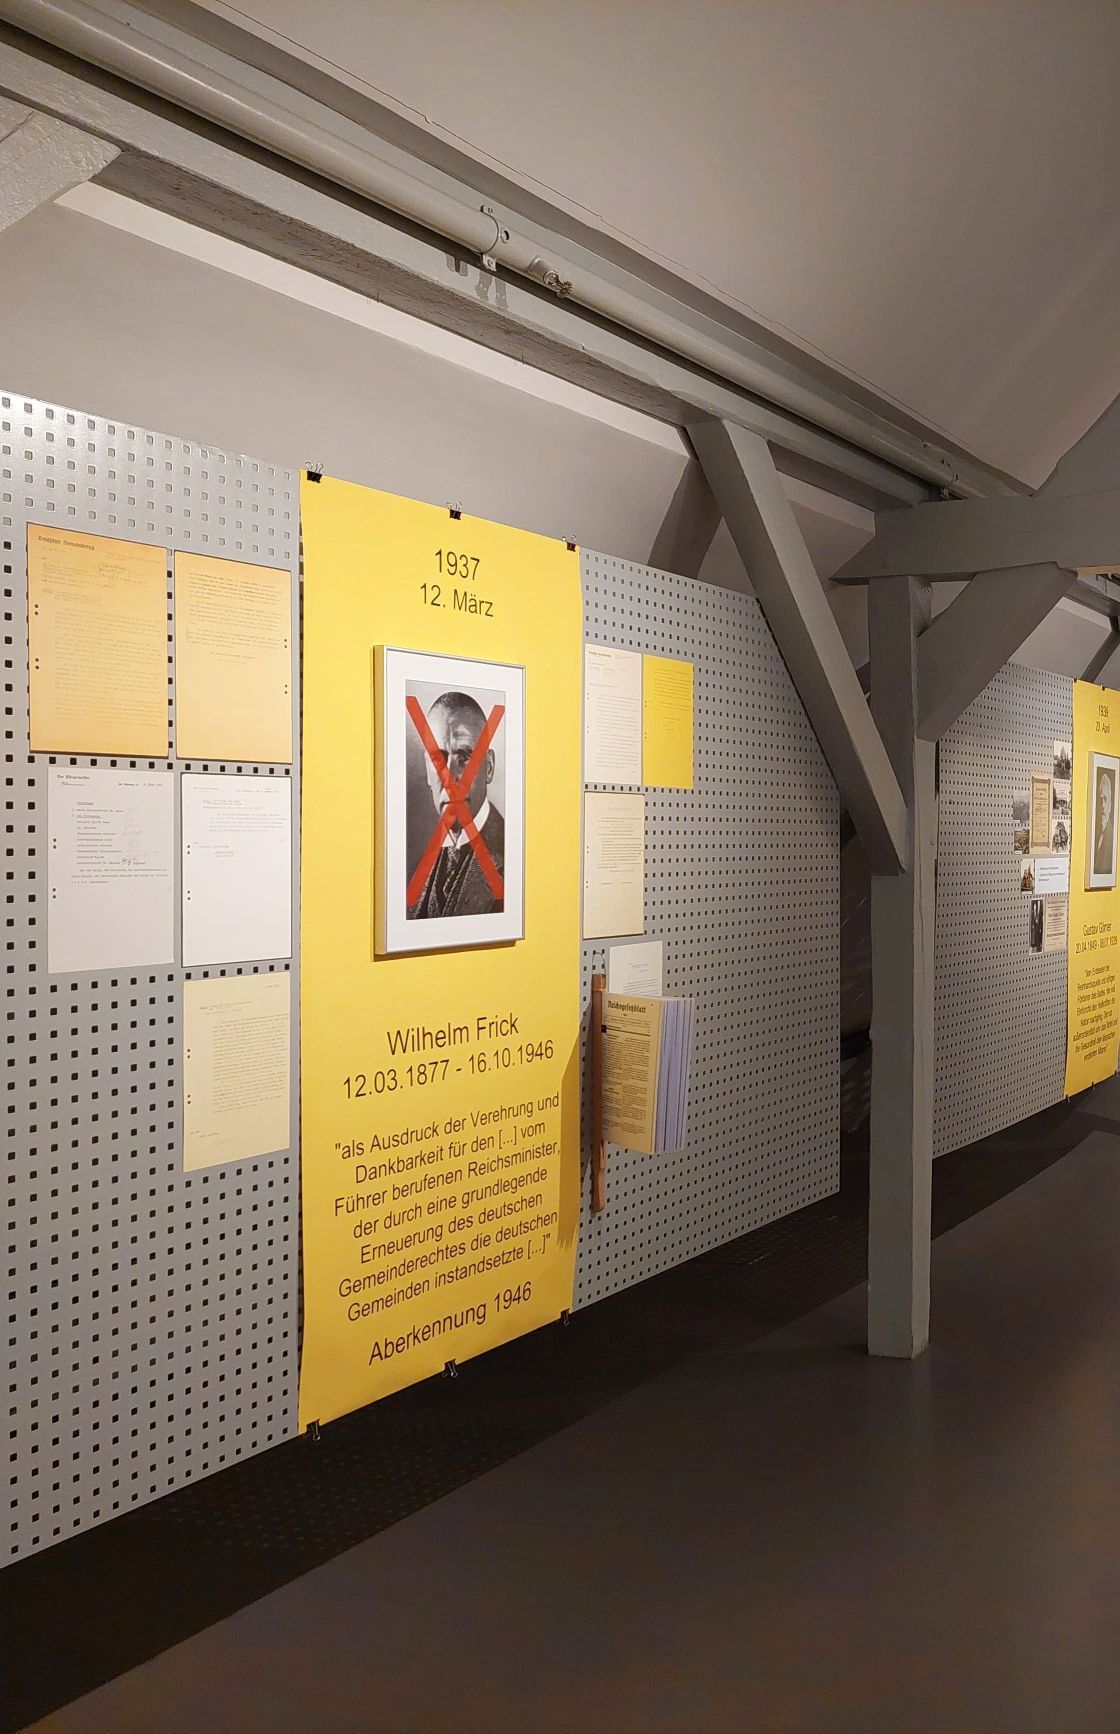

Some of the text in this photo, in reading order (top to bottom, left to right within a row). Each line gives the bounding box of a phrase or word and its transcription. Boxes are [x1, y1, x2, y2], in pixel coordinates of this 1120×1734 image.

[420, 582, 494, 618] 12. März
[435, 549, 480, 581] 1937
[343, 1059, 450, 1099] 12.03.1877
[468, 1039, 554, 1074] 16.10.1946
[387, 1012, 519, 1056] Wilhelm Frick
[335, 1090, 559, 1160] "als Ausdruck der Verehrung und
[355, 1145, 444, 1184] Dankbarkeit
[448, 1139, 466, 1160] für
[469, 1135, 495, 1155] den
[520, 1122, 546, 1141] vom
[334, 1142, 560, 1216] Führer berufenen Reichsminister,
[353, 1165, 548, 1239] der durch eine grundlegende
[338, 1208, 560, 1299] Gemeinderechtes die deutschen
[360, 1192, 542, 1265] Erneuerung des deutschen
[348, 1279, 430, 1322] Gemeinden
[434, 1247, 522, 1291] instandsetzte
[368, 1278, 532, 1366] Aberkennung 1946
